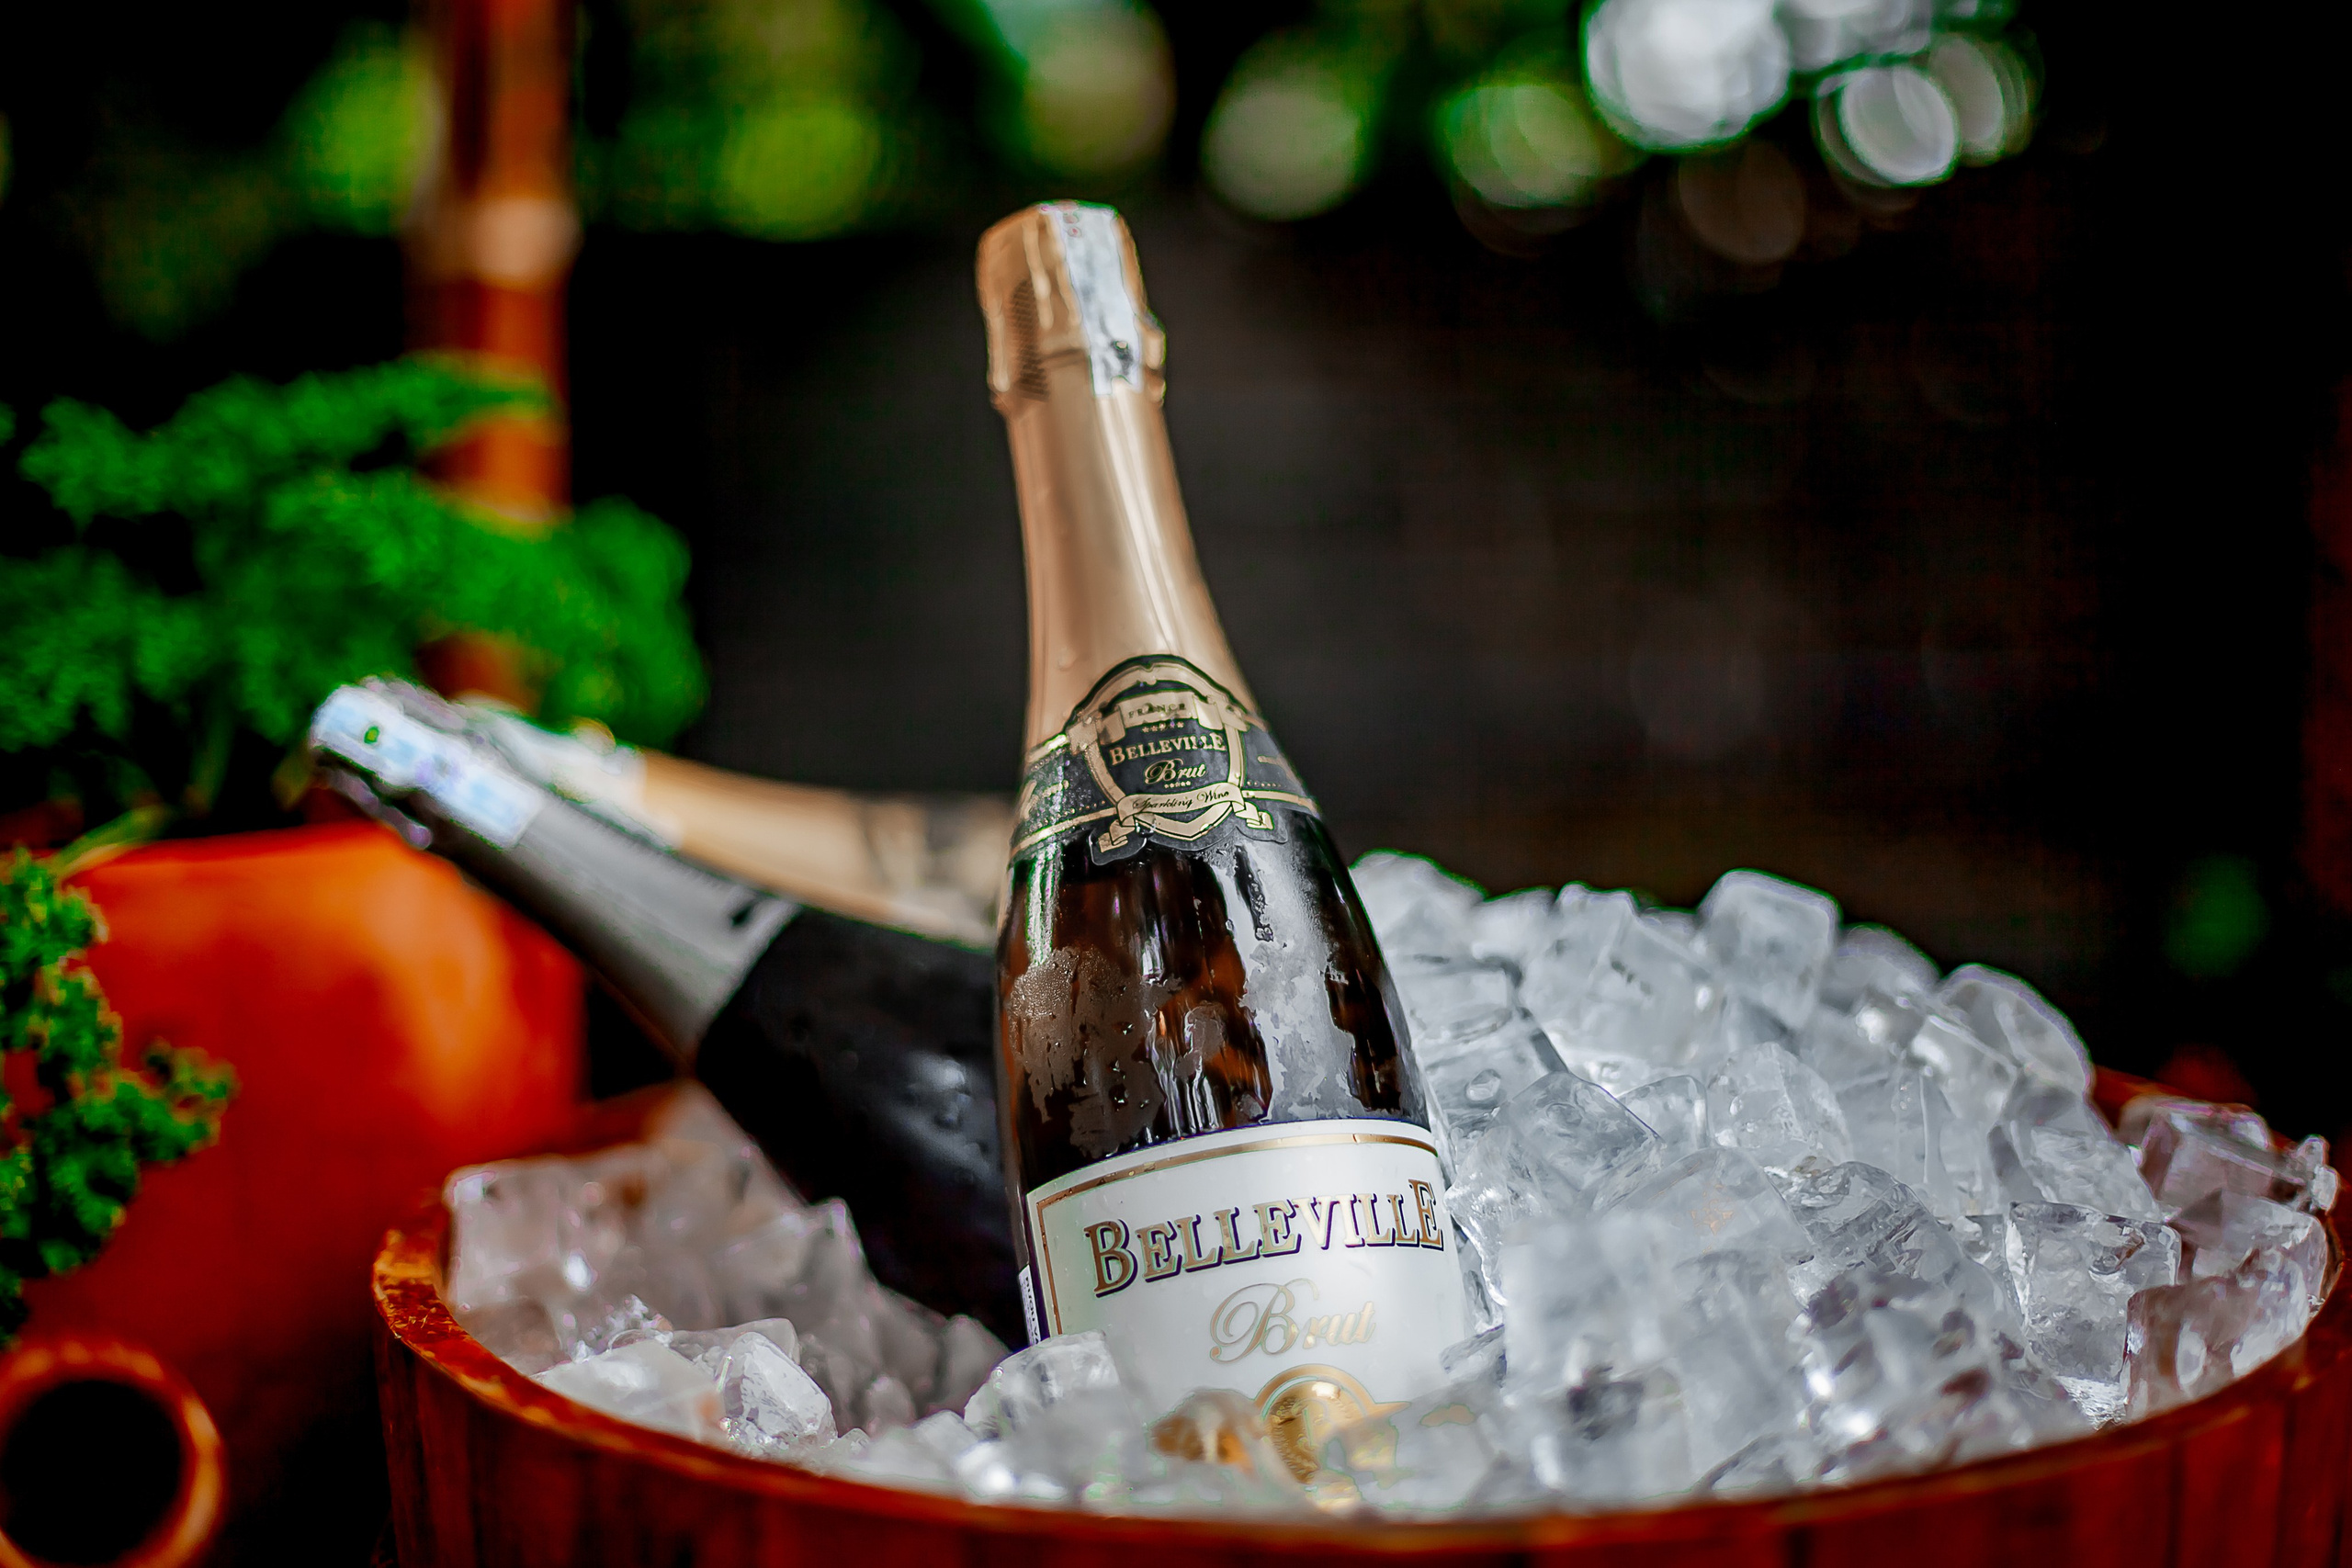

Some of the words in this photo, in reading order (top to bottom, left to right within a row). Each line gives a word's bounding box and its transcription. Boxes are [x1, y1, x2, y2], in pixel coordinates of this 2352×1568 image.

[1128, 703, 1186, 718] FRANCE
[1109, 732, 1227, 766] BELLEVILLE
[1144, 758, 1206, 784] Brut
[1132, 796, 1193, 810] Sparkling
[1196, 785, 1229, 804] Wine
[1083, 1179, 1444, 1298] BELLEVILLE
[1209, 1278, 1376, 1364] Brut
